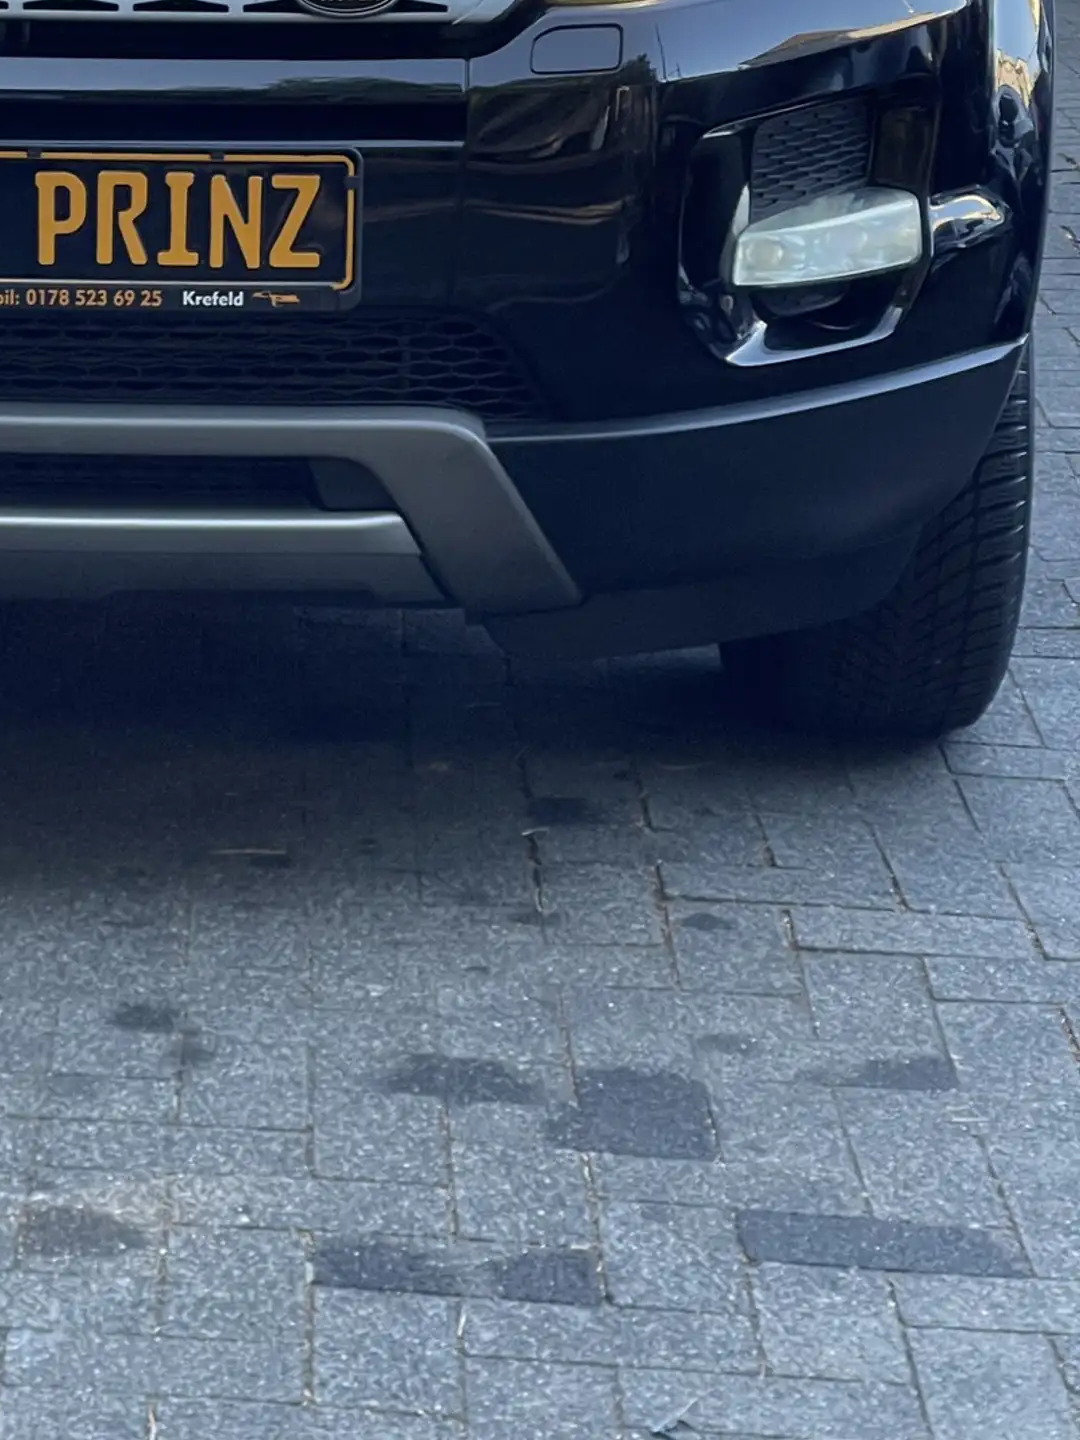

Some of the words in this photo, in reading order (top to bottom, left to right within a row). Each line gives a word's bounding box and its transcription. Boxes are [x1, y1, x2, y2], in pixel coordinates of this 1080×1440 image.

[35, 172, 321, 269] PRINZ
[26, 289, 70, 306] 0178
[75, 289, 107, 306] 523
[113, 290, 135, 307] 69
[140, 290, 162, 307] 25
[182, 290, 245, 307] Krefeld
